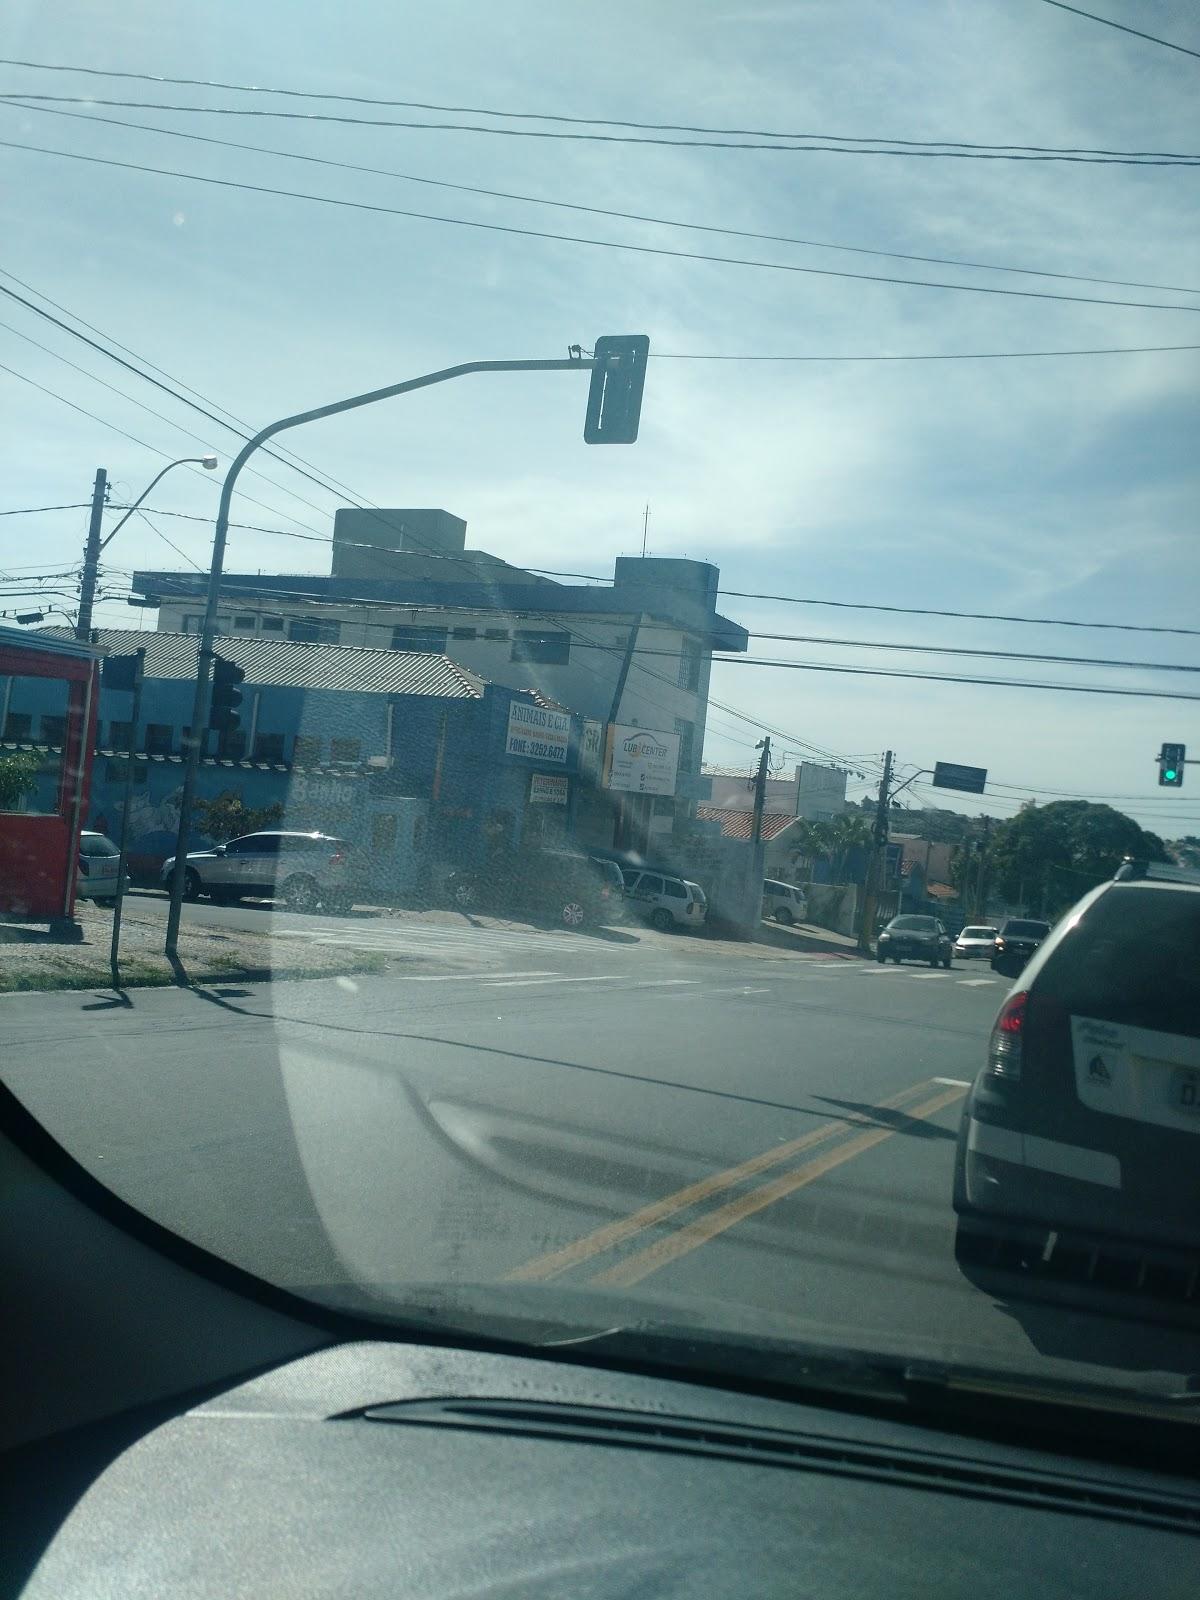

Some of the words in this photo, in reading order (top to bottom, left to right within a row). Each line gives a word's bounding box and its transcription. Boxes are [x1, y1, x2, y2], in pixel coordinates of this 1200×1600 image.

[511, 705, 547, 727] ANIMAIS
[547, 714, 554, 728] E
[641, 744, 668, 758] CENTER
